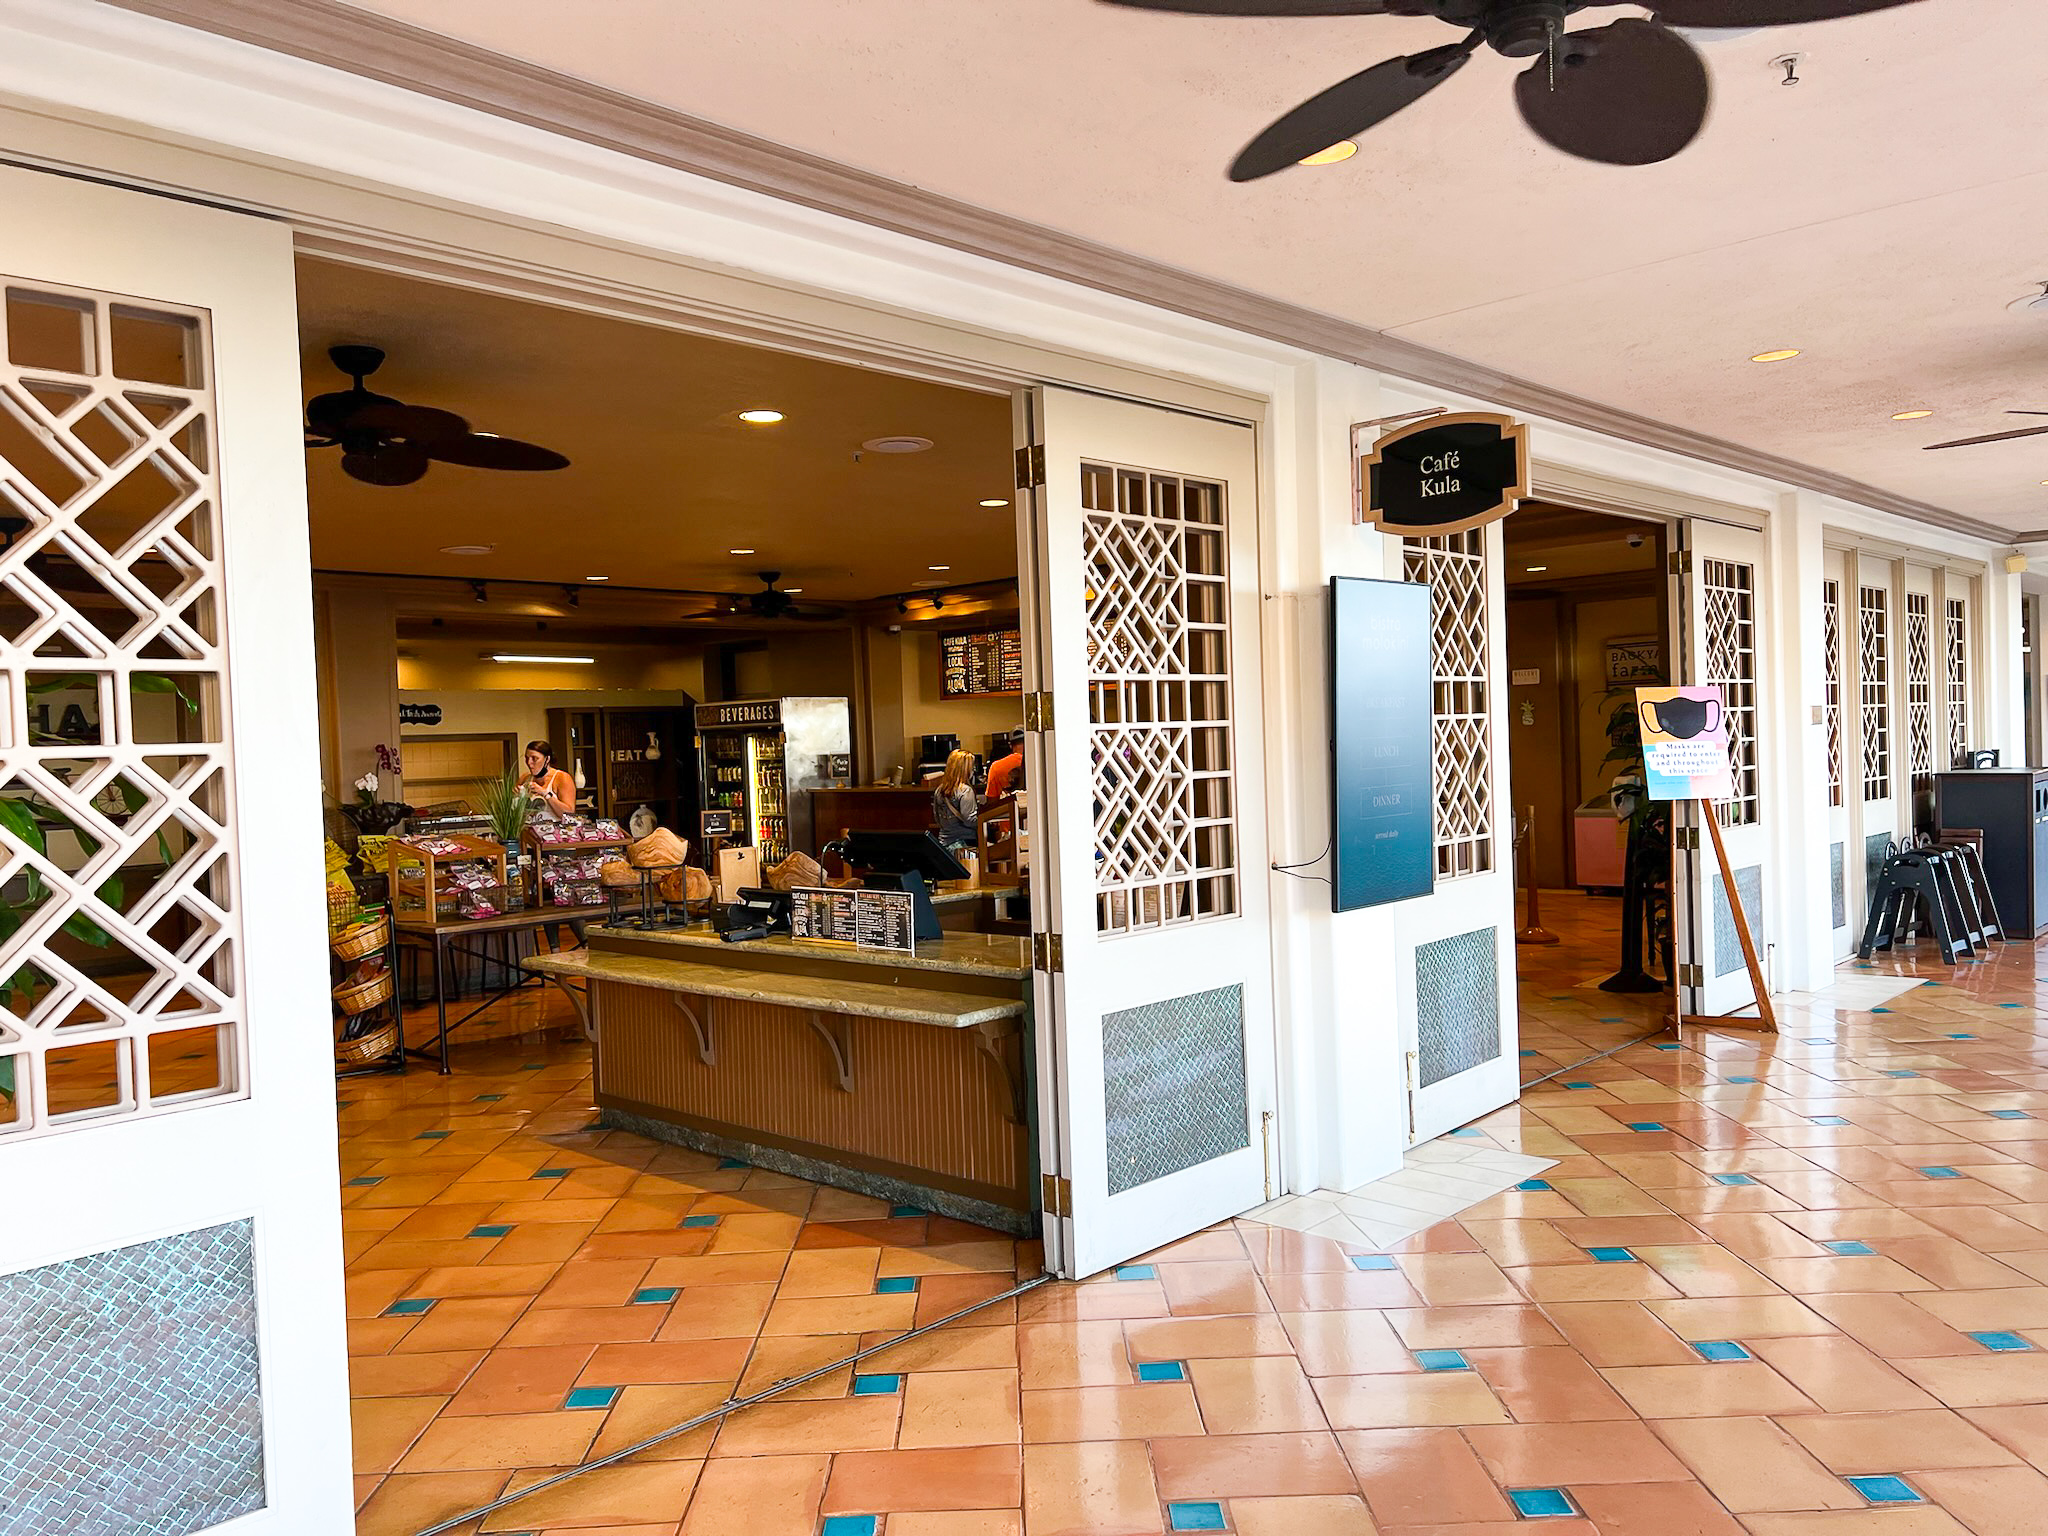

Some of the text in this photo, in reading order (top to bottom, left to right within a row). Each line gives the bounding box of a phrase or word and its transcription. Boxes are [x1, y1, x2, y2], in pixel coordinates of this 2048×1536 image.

[1420, 450, 1460, 475] Café
[1420, 475, 1461, 498] Kula
[1370, 614, 1401, 631] bistro
[1361, 631, 1409, 652] molokini
[720, 705, 774, 722] BEVERAGES
[1652, 751, 1686, 759] required
[1373, 793, 1401, 808] DINNER
